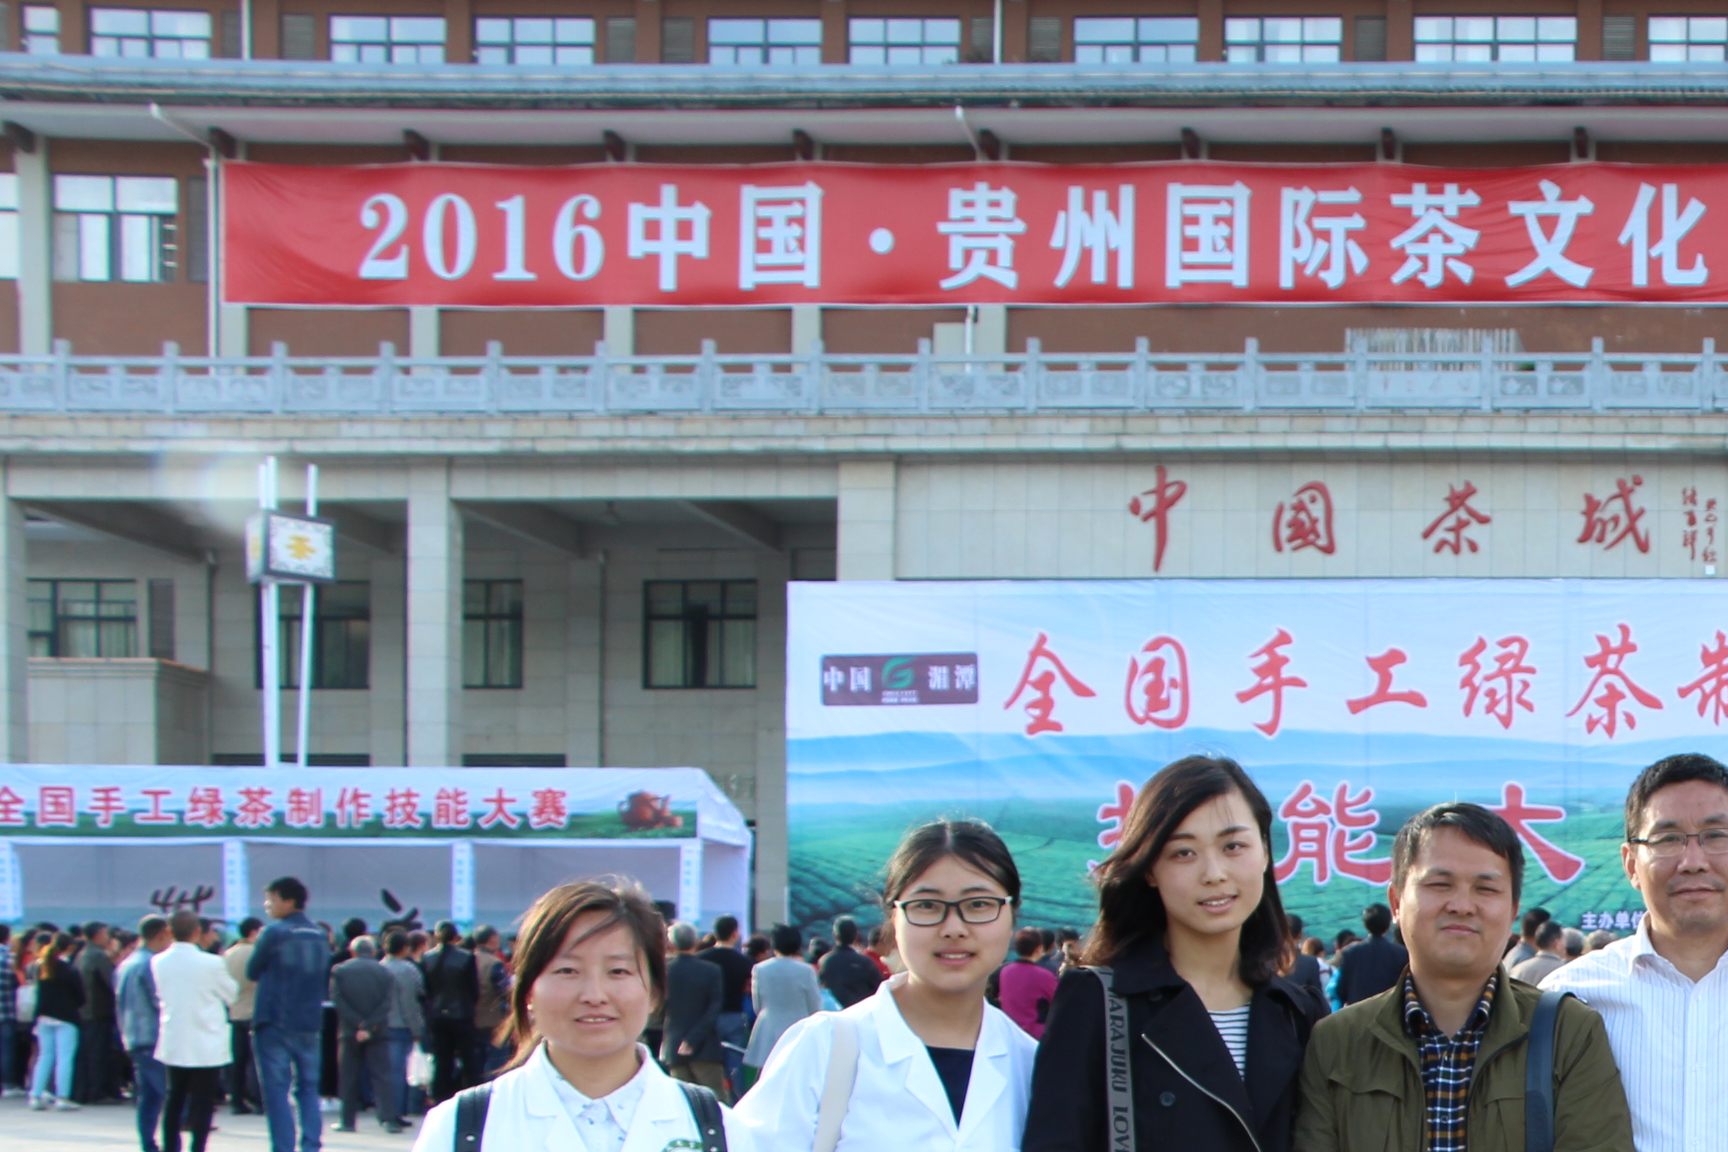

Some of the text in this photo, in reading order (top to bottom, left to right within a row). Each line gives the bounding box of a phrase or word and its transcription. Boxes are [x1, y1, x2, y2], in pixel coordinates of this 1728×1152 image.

[824, 666, 872, 692] 中国
[0, 785, 567, 828] 全国手工绿茶制作技能大赛
